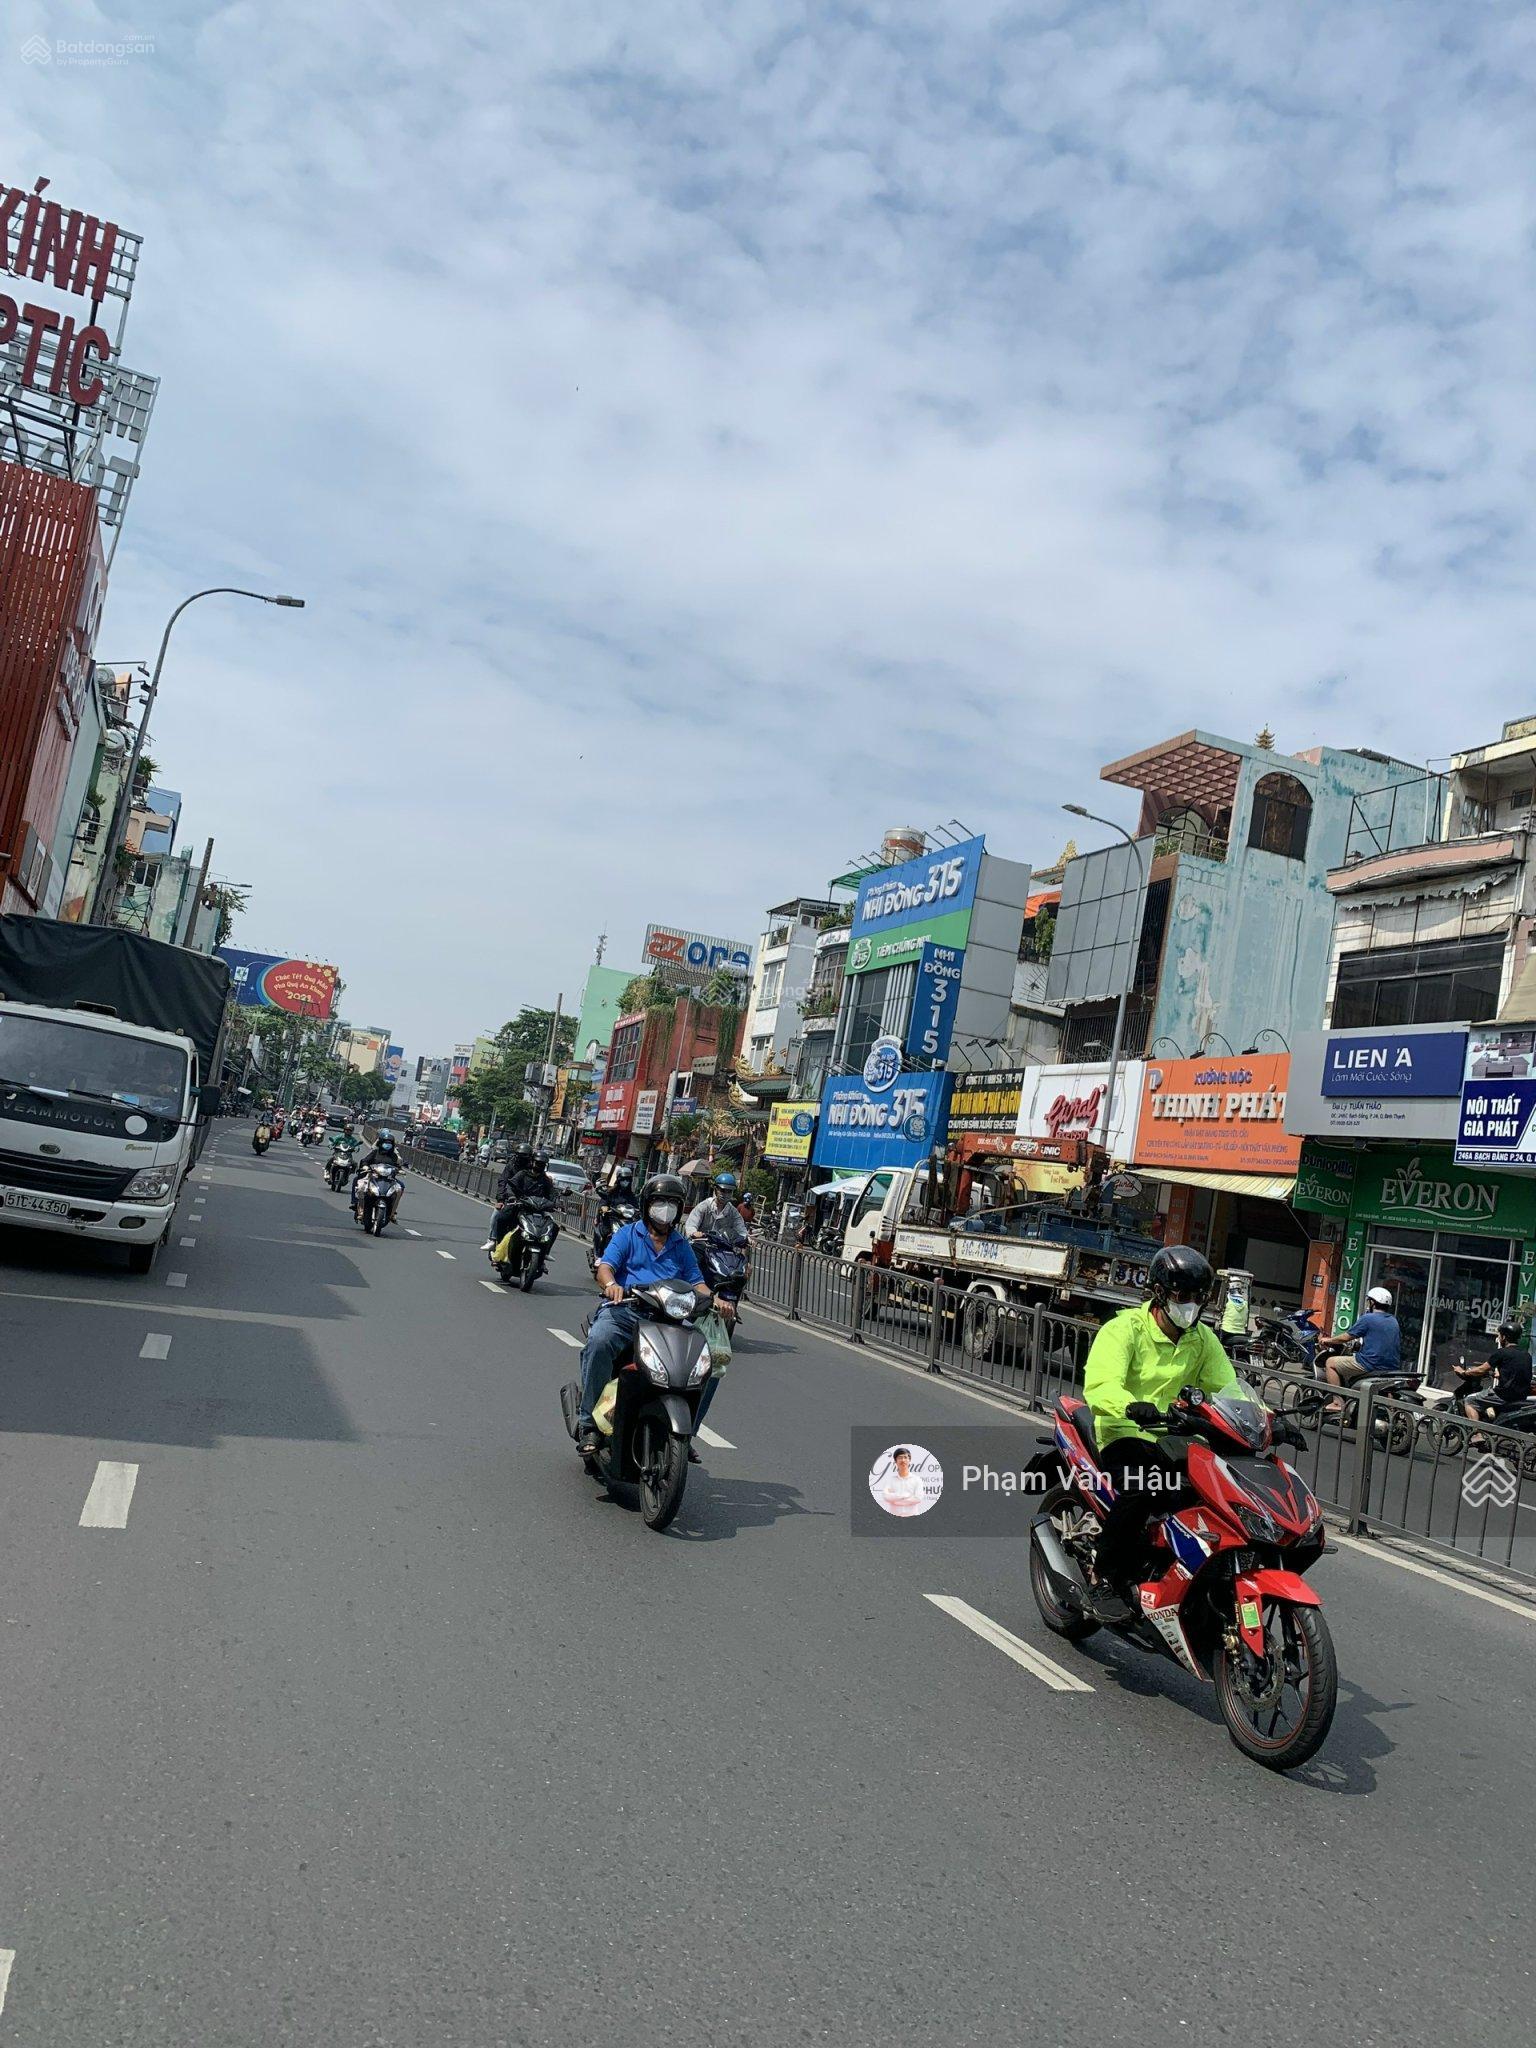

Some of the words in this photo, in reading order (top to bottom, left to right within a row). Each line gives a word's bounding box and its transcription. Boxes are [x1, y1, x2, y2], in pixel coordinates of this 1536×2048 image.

[862, 897, 884, 921] NHI
[884, 882, 925, 915] ĐỒNG
[924, 856, 965, 903] 315
[933, 947, 956, 963] NHI
[924, 959, 961, 980] ĐỒNG
[1194, 1066, 1227, 1085] XƯỞNG
[1228, 1067, 1253, 1087] MỘC
[2, 1101, 51, 1118] VEAM
[55, 1111, 117, 1129] MOTOR
[828, 1104, 849, 1125] NHI
[849, 1094, 888, 1127] ĐỒNG
[888, 1088, 928, 1127] 315
[1152, 1093, 1220, 1126] THỊNH
[1223, 1084, 1287, 1120] PHÁT
[1466, 1095, 1489, 1118] NỘI
[1491, 1093, 1521, 1116] THẤT
[1463, 1120, 1484, 1137] GIA
[1487, 1117, 1519, 1137] PHÁT
[1474, 1152, 1490, 1162] BẠCH
[1492, 1151, 1509, 1162] ĐẰNG
[1297, 1182, 1351, 1205] EVERON
[1380, 1178, 1500, 1213] EVERON
[1148, 1608, 1178, 1621] HONDA
